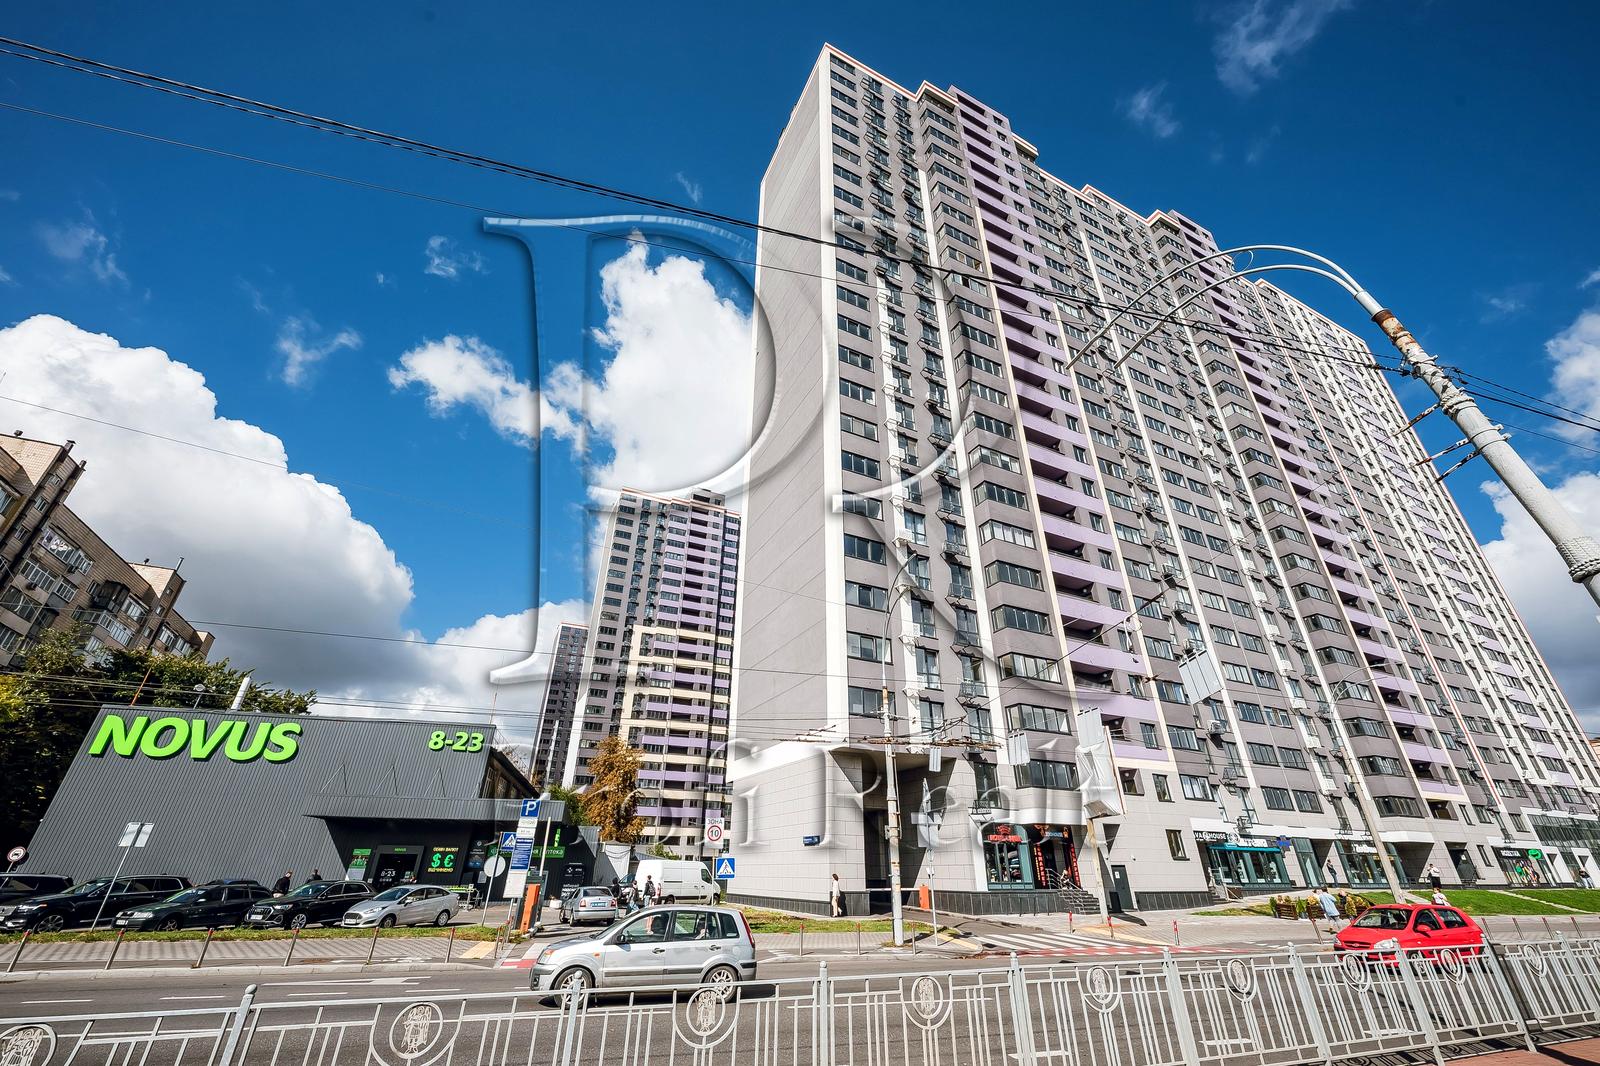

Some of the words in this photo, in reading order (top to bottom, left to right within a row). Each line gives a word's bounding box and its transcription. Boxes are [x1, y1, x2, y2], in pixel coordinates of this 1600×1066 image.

[88, 714, 302, 762] NOVUS
[428, 730, 484, 753] 8-23
[525, 800, 537, 815] P
[709, 829, 719, 838] 10
